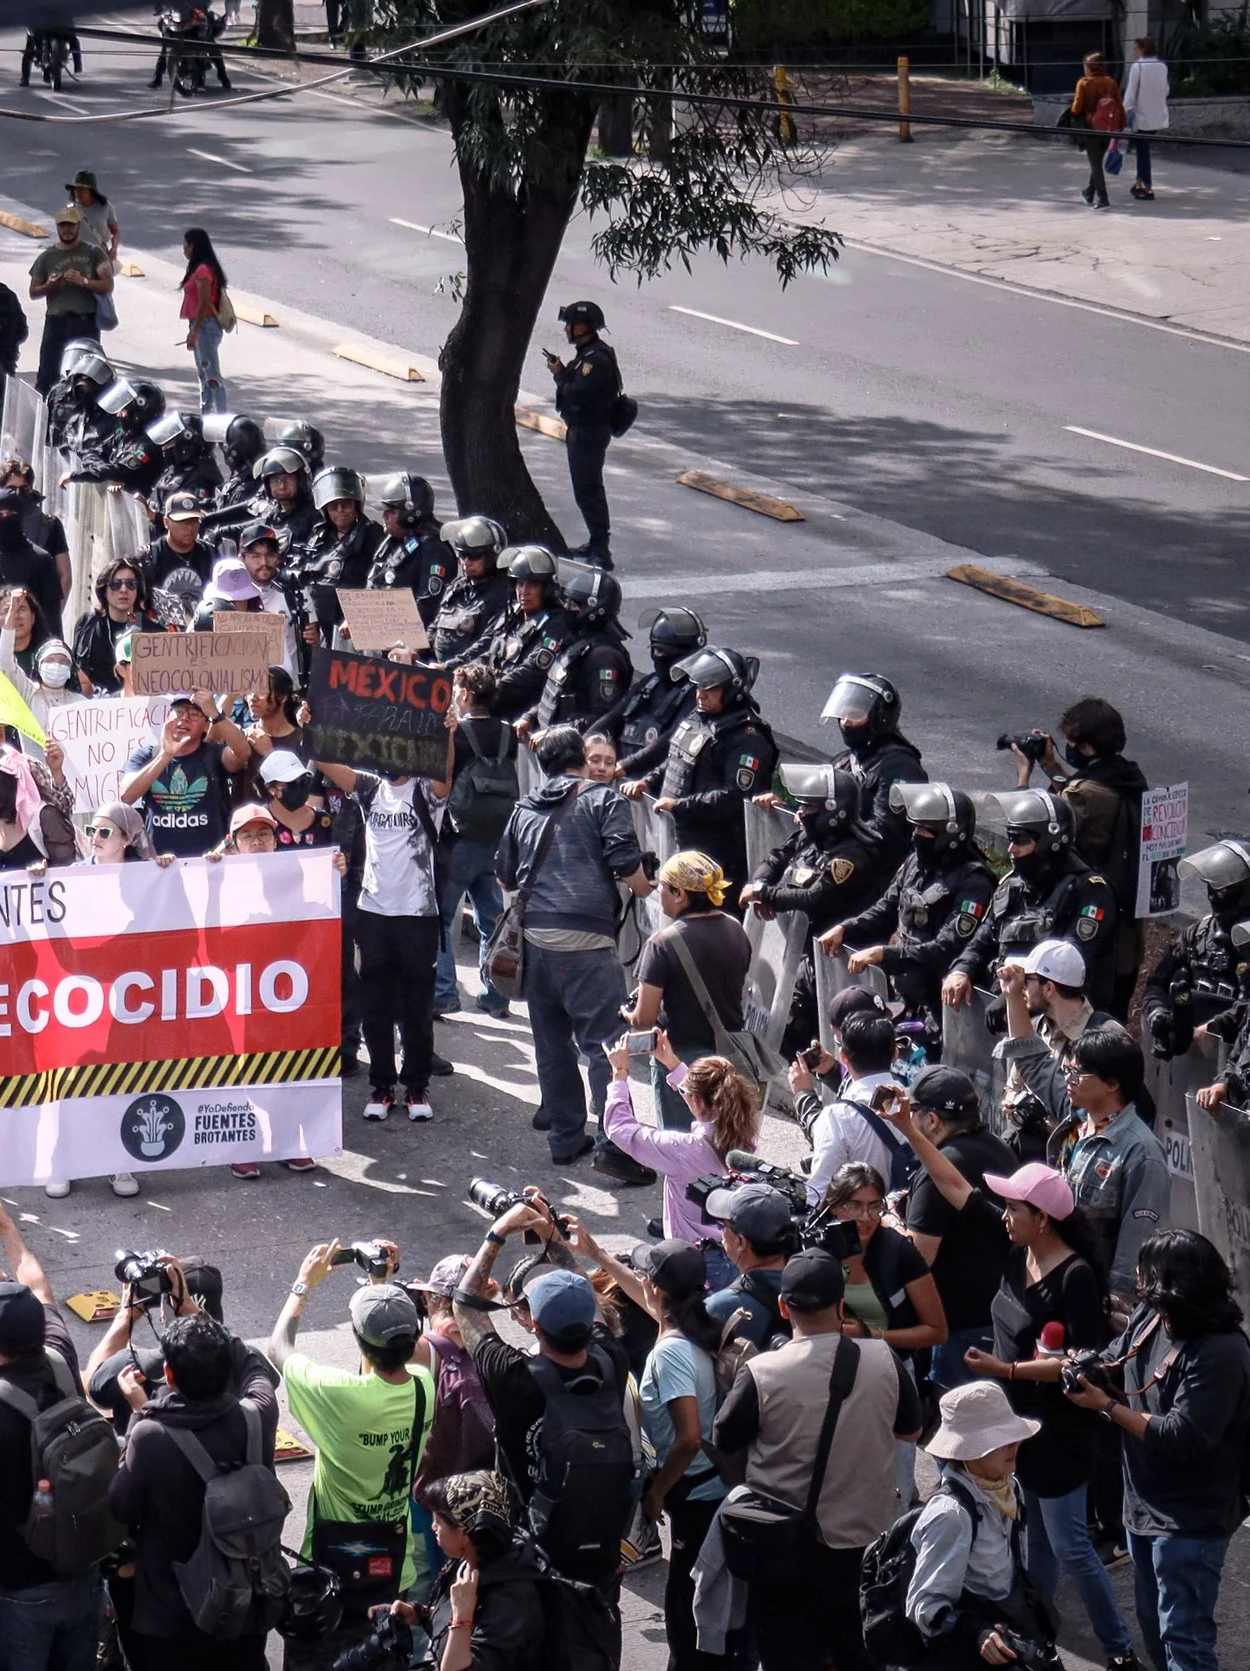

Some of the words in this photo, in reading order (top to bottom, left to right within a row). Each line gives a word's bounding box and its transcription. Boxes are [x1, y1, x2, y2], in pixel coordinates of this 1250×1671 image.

[136, 669, 269, 692] NEOCOLONIALISMO
[329, 658, 451, 713] MÉXICO
[51, 704, 170, 742] GENTRIFICACI
[87, 741, 116, 767] NO
[152, 812, 209, 829] adidas
[197, 1100, 255, 1114] #YoDefiendo
[195, 1112, 256, 1131] FUENTES
[194, 1129, 257, 1145] BROTANTES
[390, 1428, 410, 1445] YOUR
